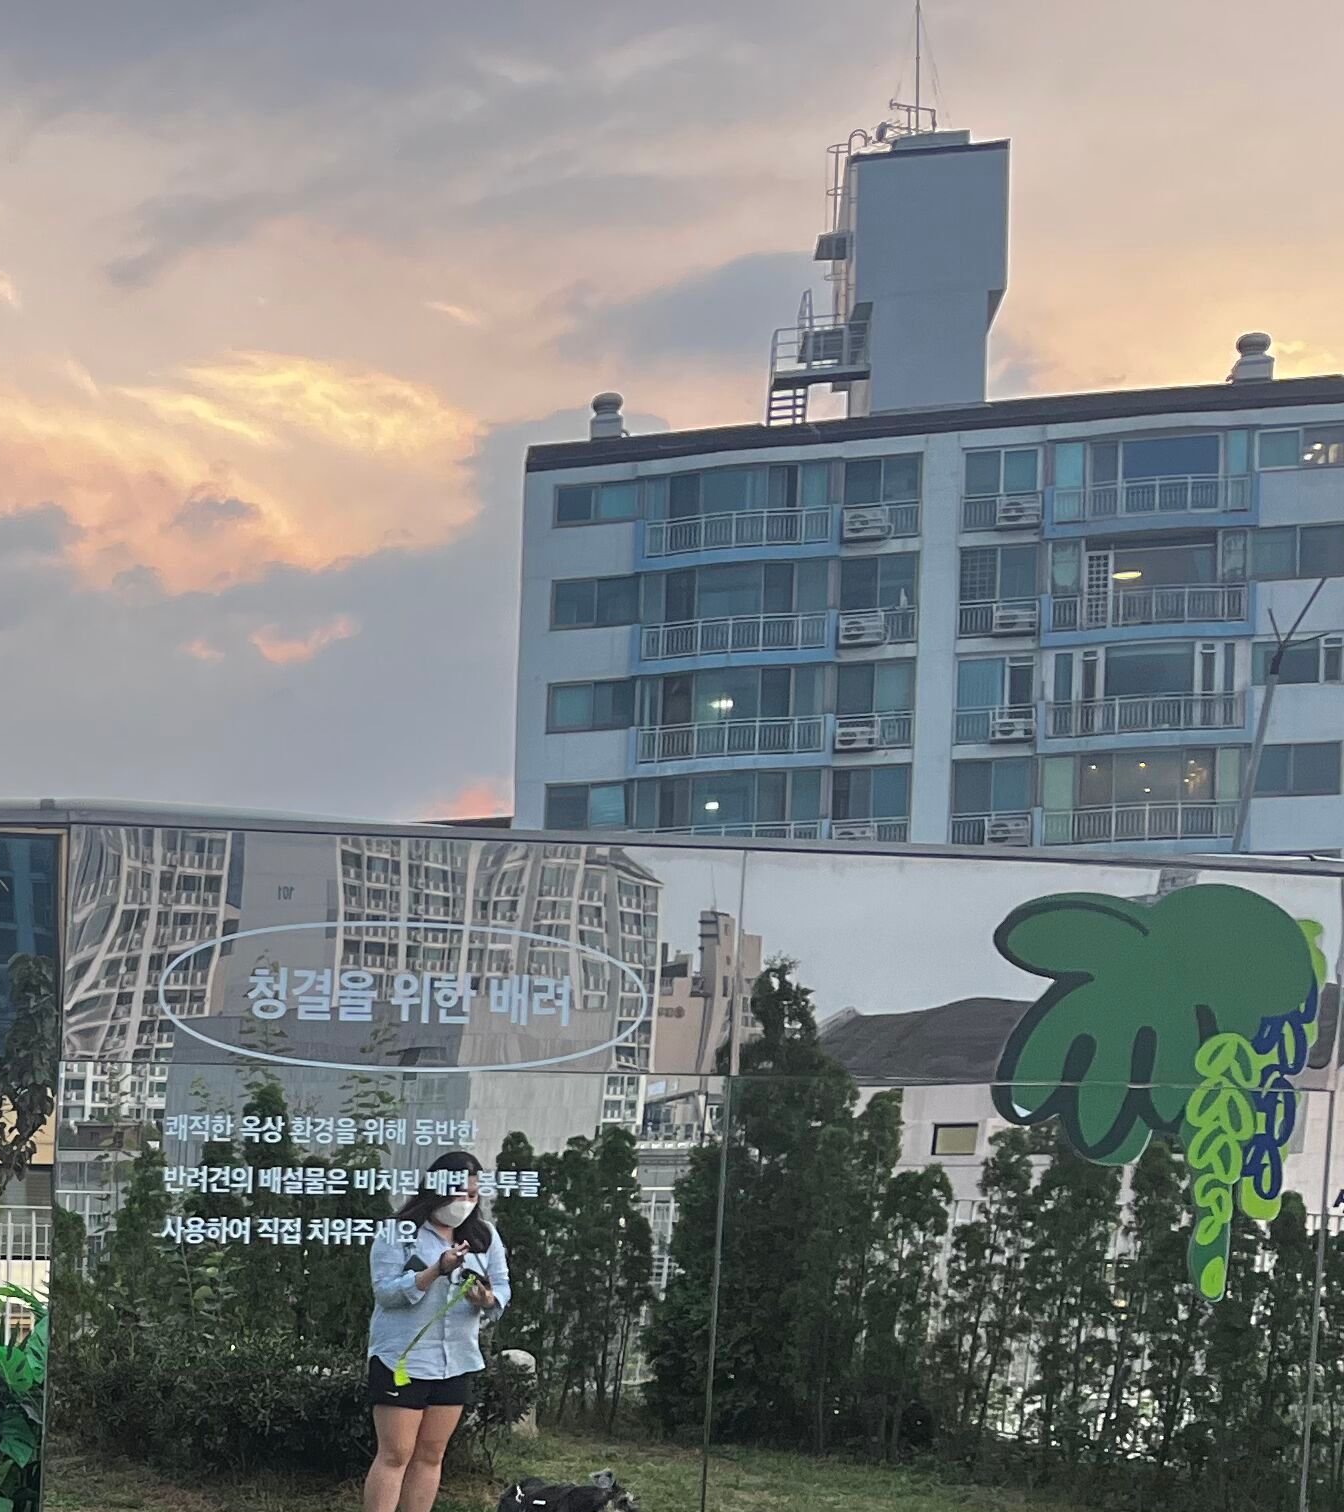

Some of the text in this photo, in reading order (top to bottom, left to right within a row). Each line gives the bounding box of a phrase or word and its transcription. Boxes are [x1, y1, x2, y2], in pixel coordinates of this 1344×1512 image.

[247, 967, 571, 1026] 청결을 위한 배려
[165, 1114, 480, 1146] 쾌적한 옥상 환경을 위해 동반한
[162, 1165, 540, 1197] 반려견의 배설물은 비치된 배변 봉투를
[161, 1216, 251, 1244] 사용하여
[257, 1217, 302, 1245] 직접
